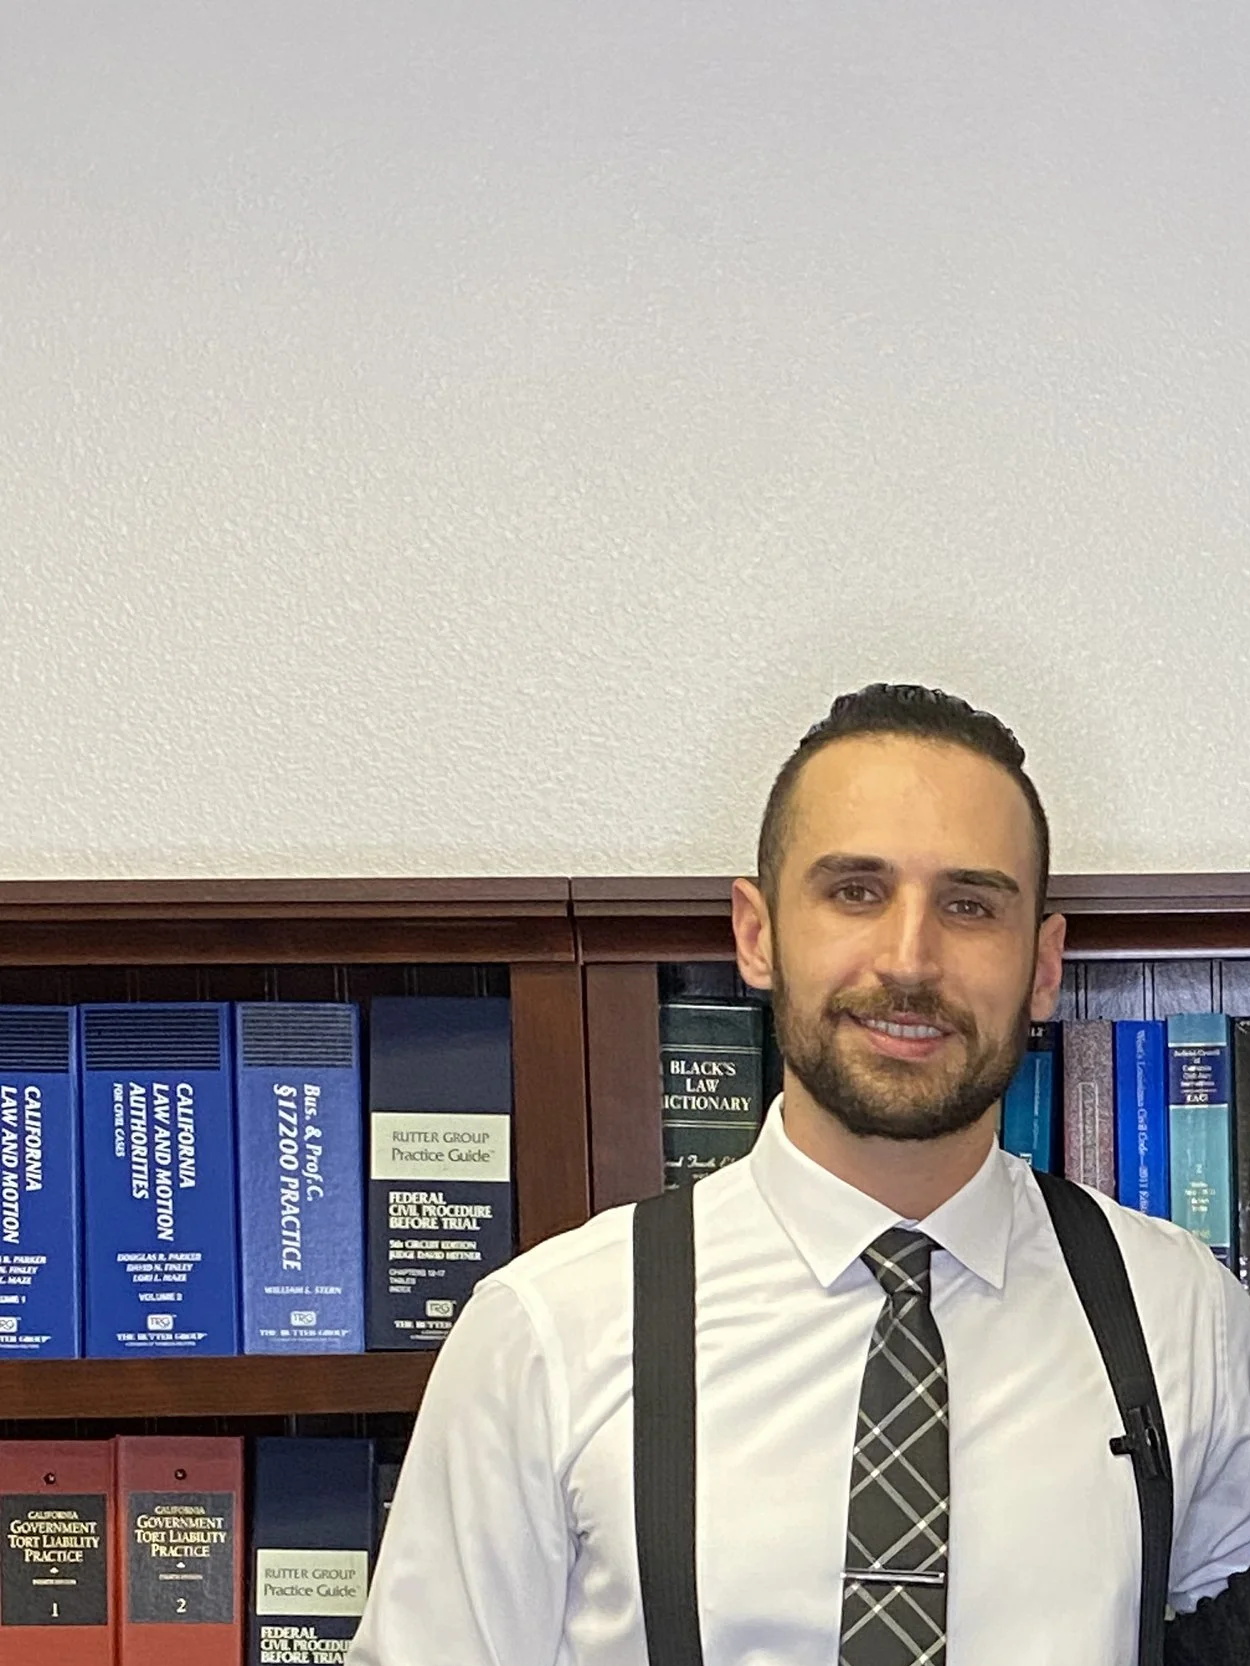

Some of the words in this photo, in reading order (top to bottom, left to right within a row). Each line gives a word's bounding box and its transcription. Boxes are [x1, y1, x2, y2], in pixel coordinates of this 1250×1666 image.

[670, 1060, 736, 1076] BLACK'S
[113, 1083, 123, 1101] FOR
[686, 1078, 719, 1093] LAW
[1, 1085, 18, 1127] LAW
[152, 1082, 170, 1124] LAW
[304, 1083, 320, 1121] Bus.
[663, 1095, 751, 1111] ICTIONARY
[114, 1104, 124, 1127] CIVIL
[177, 1082, 195, 1188] CALIFORNIA
[273, 1084, 298, 1171] §17200
[303, 1125, 322, 1141] &
[24, 1085, 42, 1191] CALIFORNIA
[115, 1129, 125, 1157] CASES
[129, 1082, 149, 1199] AUTHORITIES
[392, 1131, 439, 1143] RUTTER
[443, 1132, 489, 1144] GROUP
[2, 1130, 18, 1168] AND
[153, 1127, 171, 1165] AND
[391, 1148, 444, 1162] Practice
[448, 1148, 490, 1162] Guide
[155, 1168, 174, 1241] MOTION
[389, 1191, 446, 1204] FEDERAL
[2, 1171, 20, 1244] MOTION
[389, 1205, 419, 1217] CIVIL
[422, 1206, 493, 1218] PROCEDURE
[280, 1176, 301, 1271] PRACTICE
[389, 1217, 438, 1229] BEFORE
[442, 1218, 480, 1230] TRIAL
[28, 1510, 79, 1520] CALIFORNIA
[155, 1506, 206, 1515] CALIFORNIA
[10, 1519, 97, 1535] GOVERNMENT
[136, 1515, 224, 1530] GOVERNMENT
[7, 1534, 39, 1548] TORT
[42, 1535, 100, 1549] LIABILITY
[135, 1529, 166, 1543] TORT
[169, 1530, 227, 1544] LIABILITY
[24, 1549, 83, 1562] PRACTICE
[151, 1544, 210, 1558] PRACTICE
[265, 1568, 308, 1580] RUTTER
[312, 1568, 356, 1580] GROUP
[263, 1584, 313, 1598] Practice
[316, 1584, 357, 1598] Guide
[52, 1602, 59, 1617] 1
[176, 1598, 187, 1613] 2
[260, 1626, 317, 1640] FEDERAL
[260, 1640, 291, 1651] CIVIL
[261, 1651, 309, 1664] BEFORE
[313, 1652, 344, 1665] TRIA
